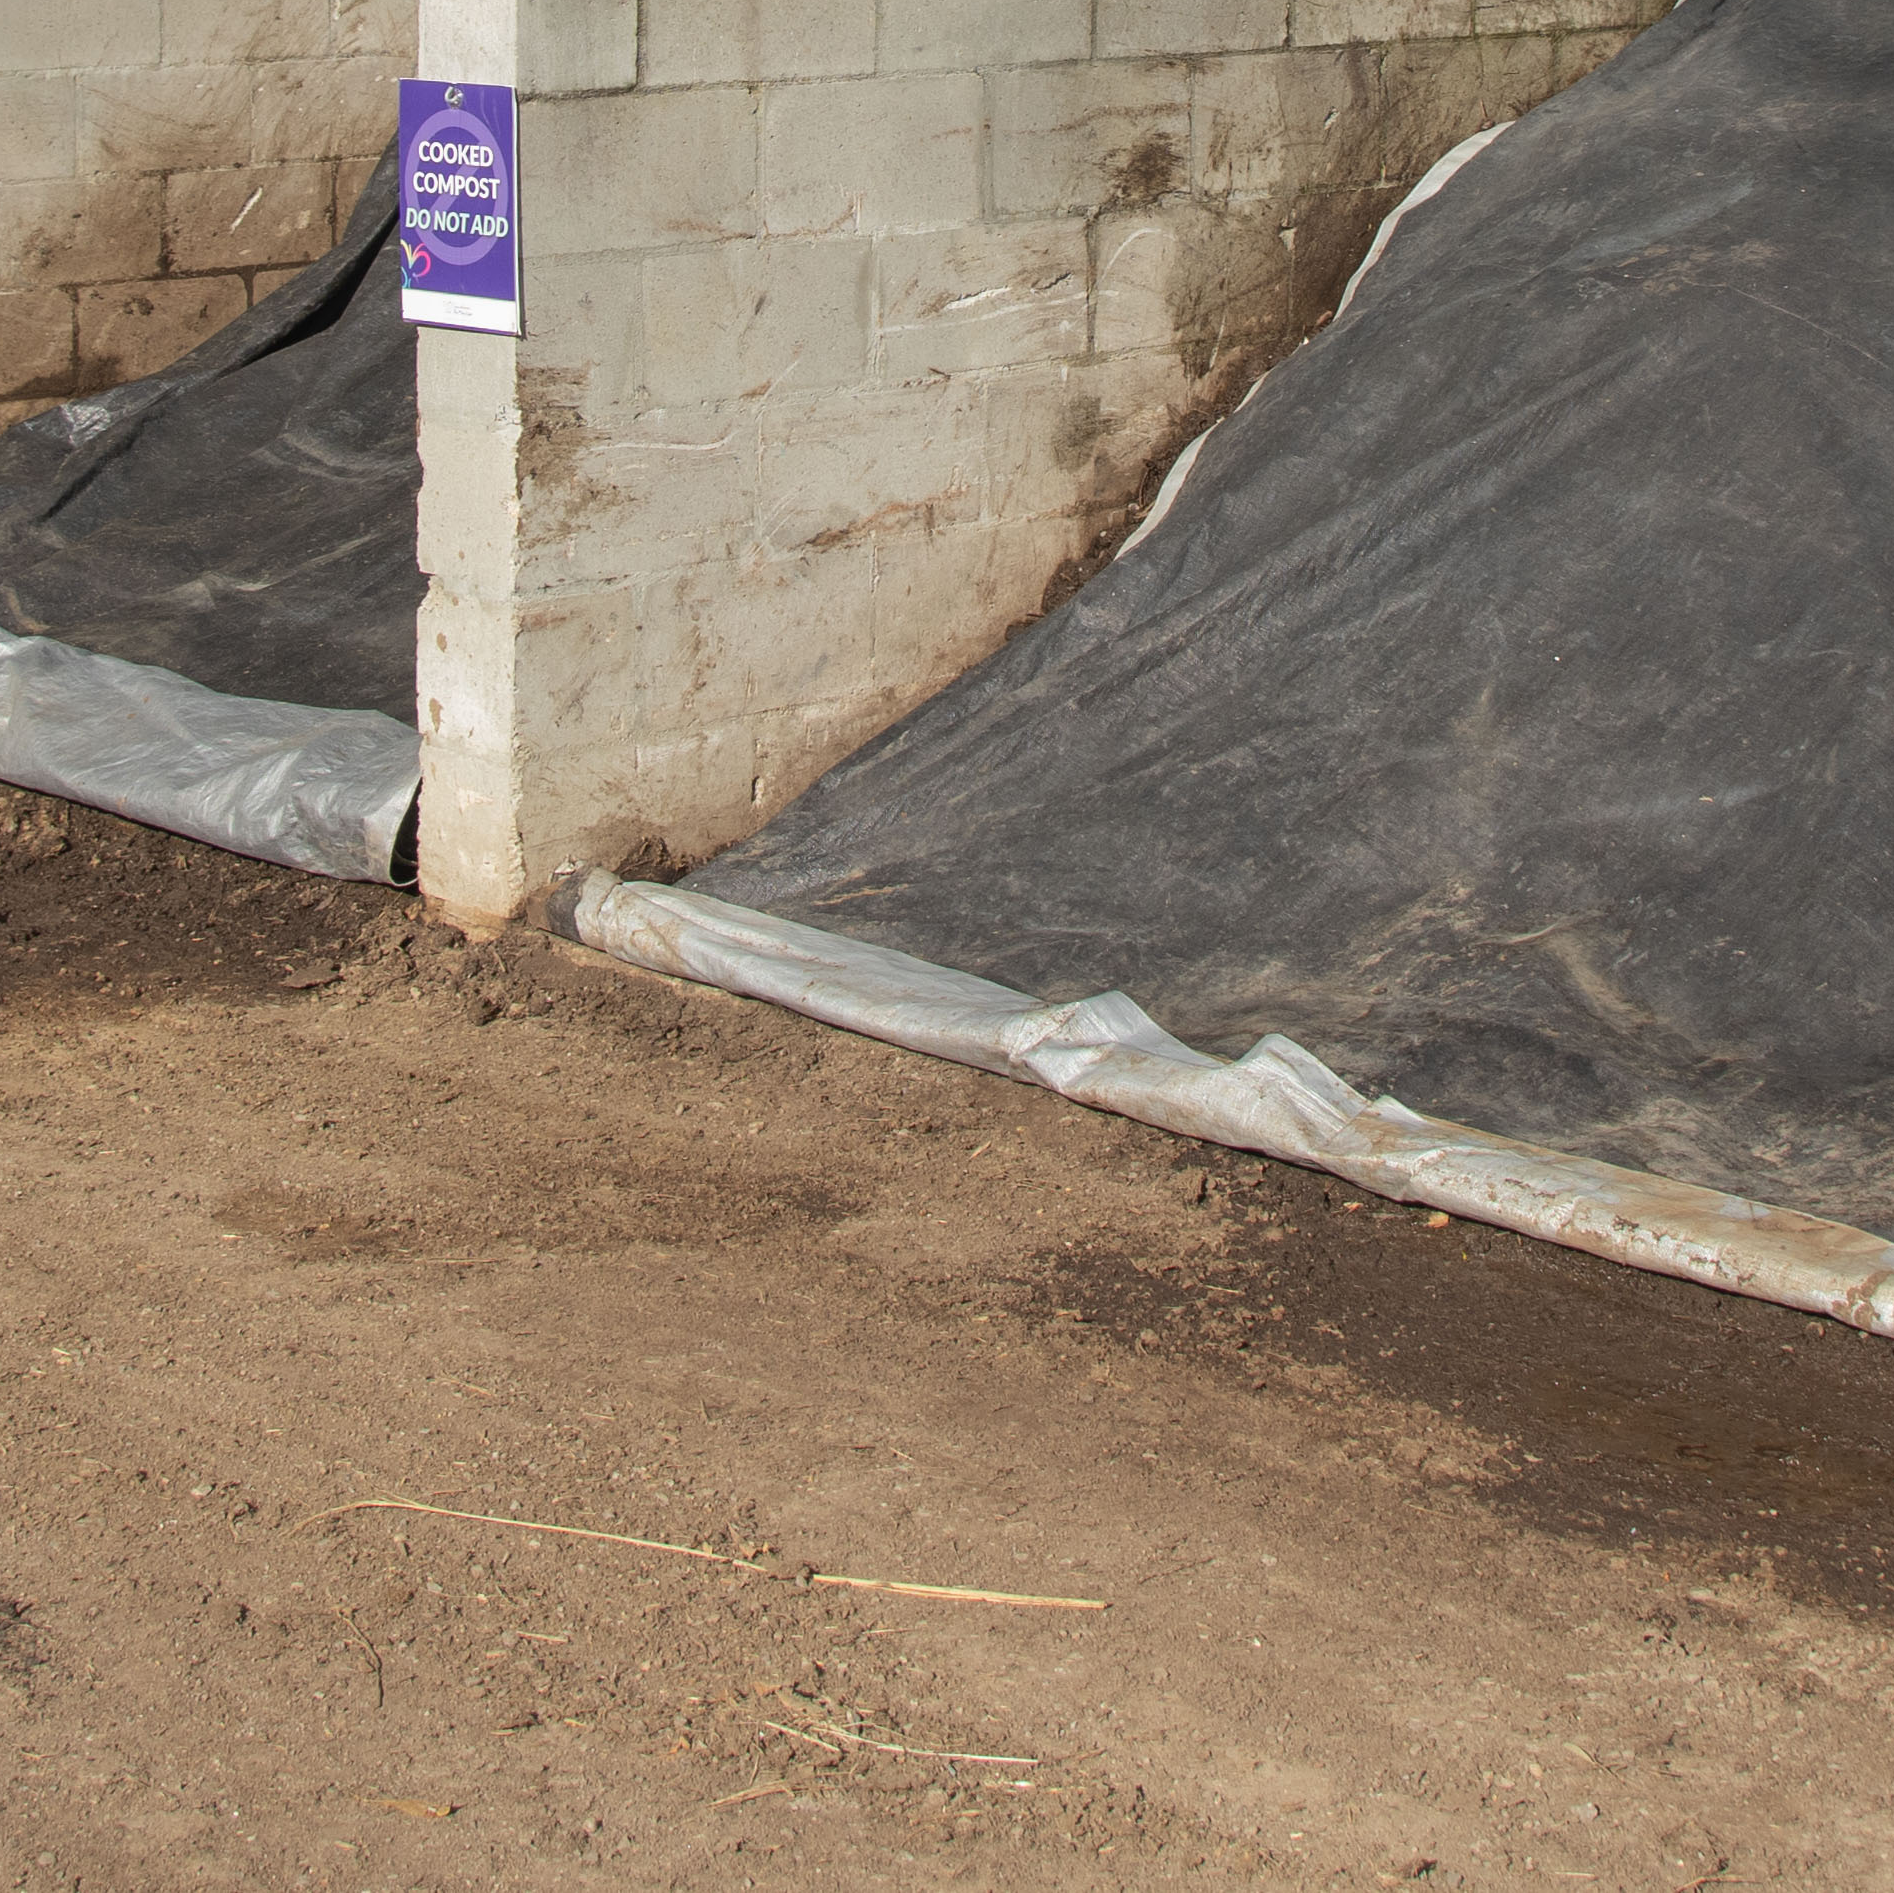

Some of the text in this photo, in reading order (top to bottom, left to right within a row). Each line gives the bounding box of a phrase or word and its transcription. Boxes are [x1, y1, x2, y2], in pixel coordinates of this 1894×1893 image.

[418, 141, 493, 167] COOKED
[413, 172, 500, 199] COMPOST
[406, 207, 508, 237] DO NOT ADD
